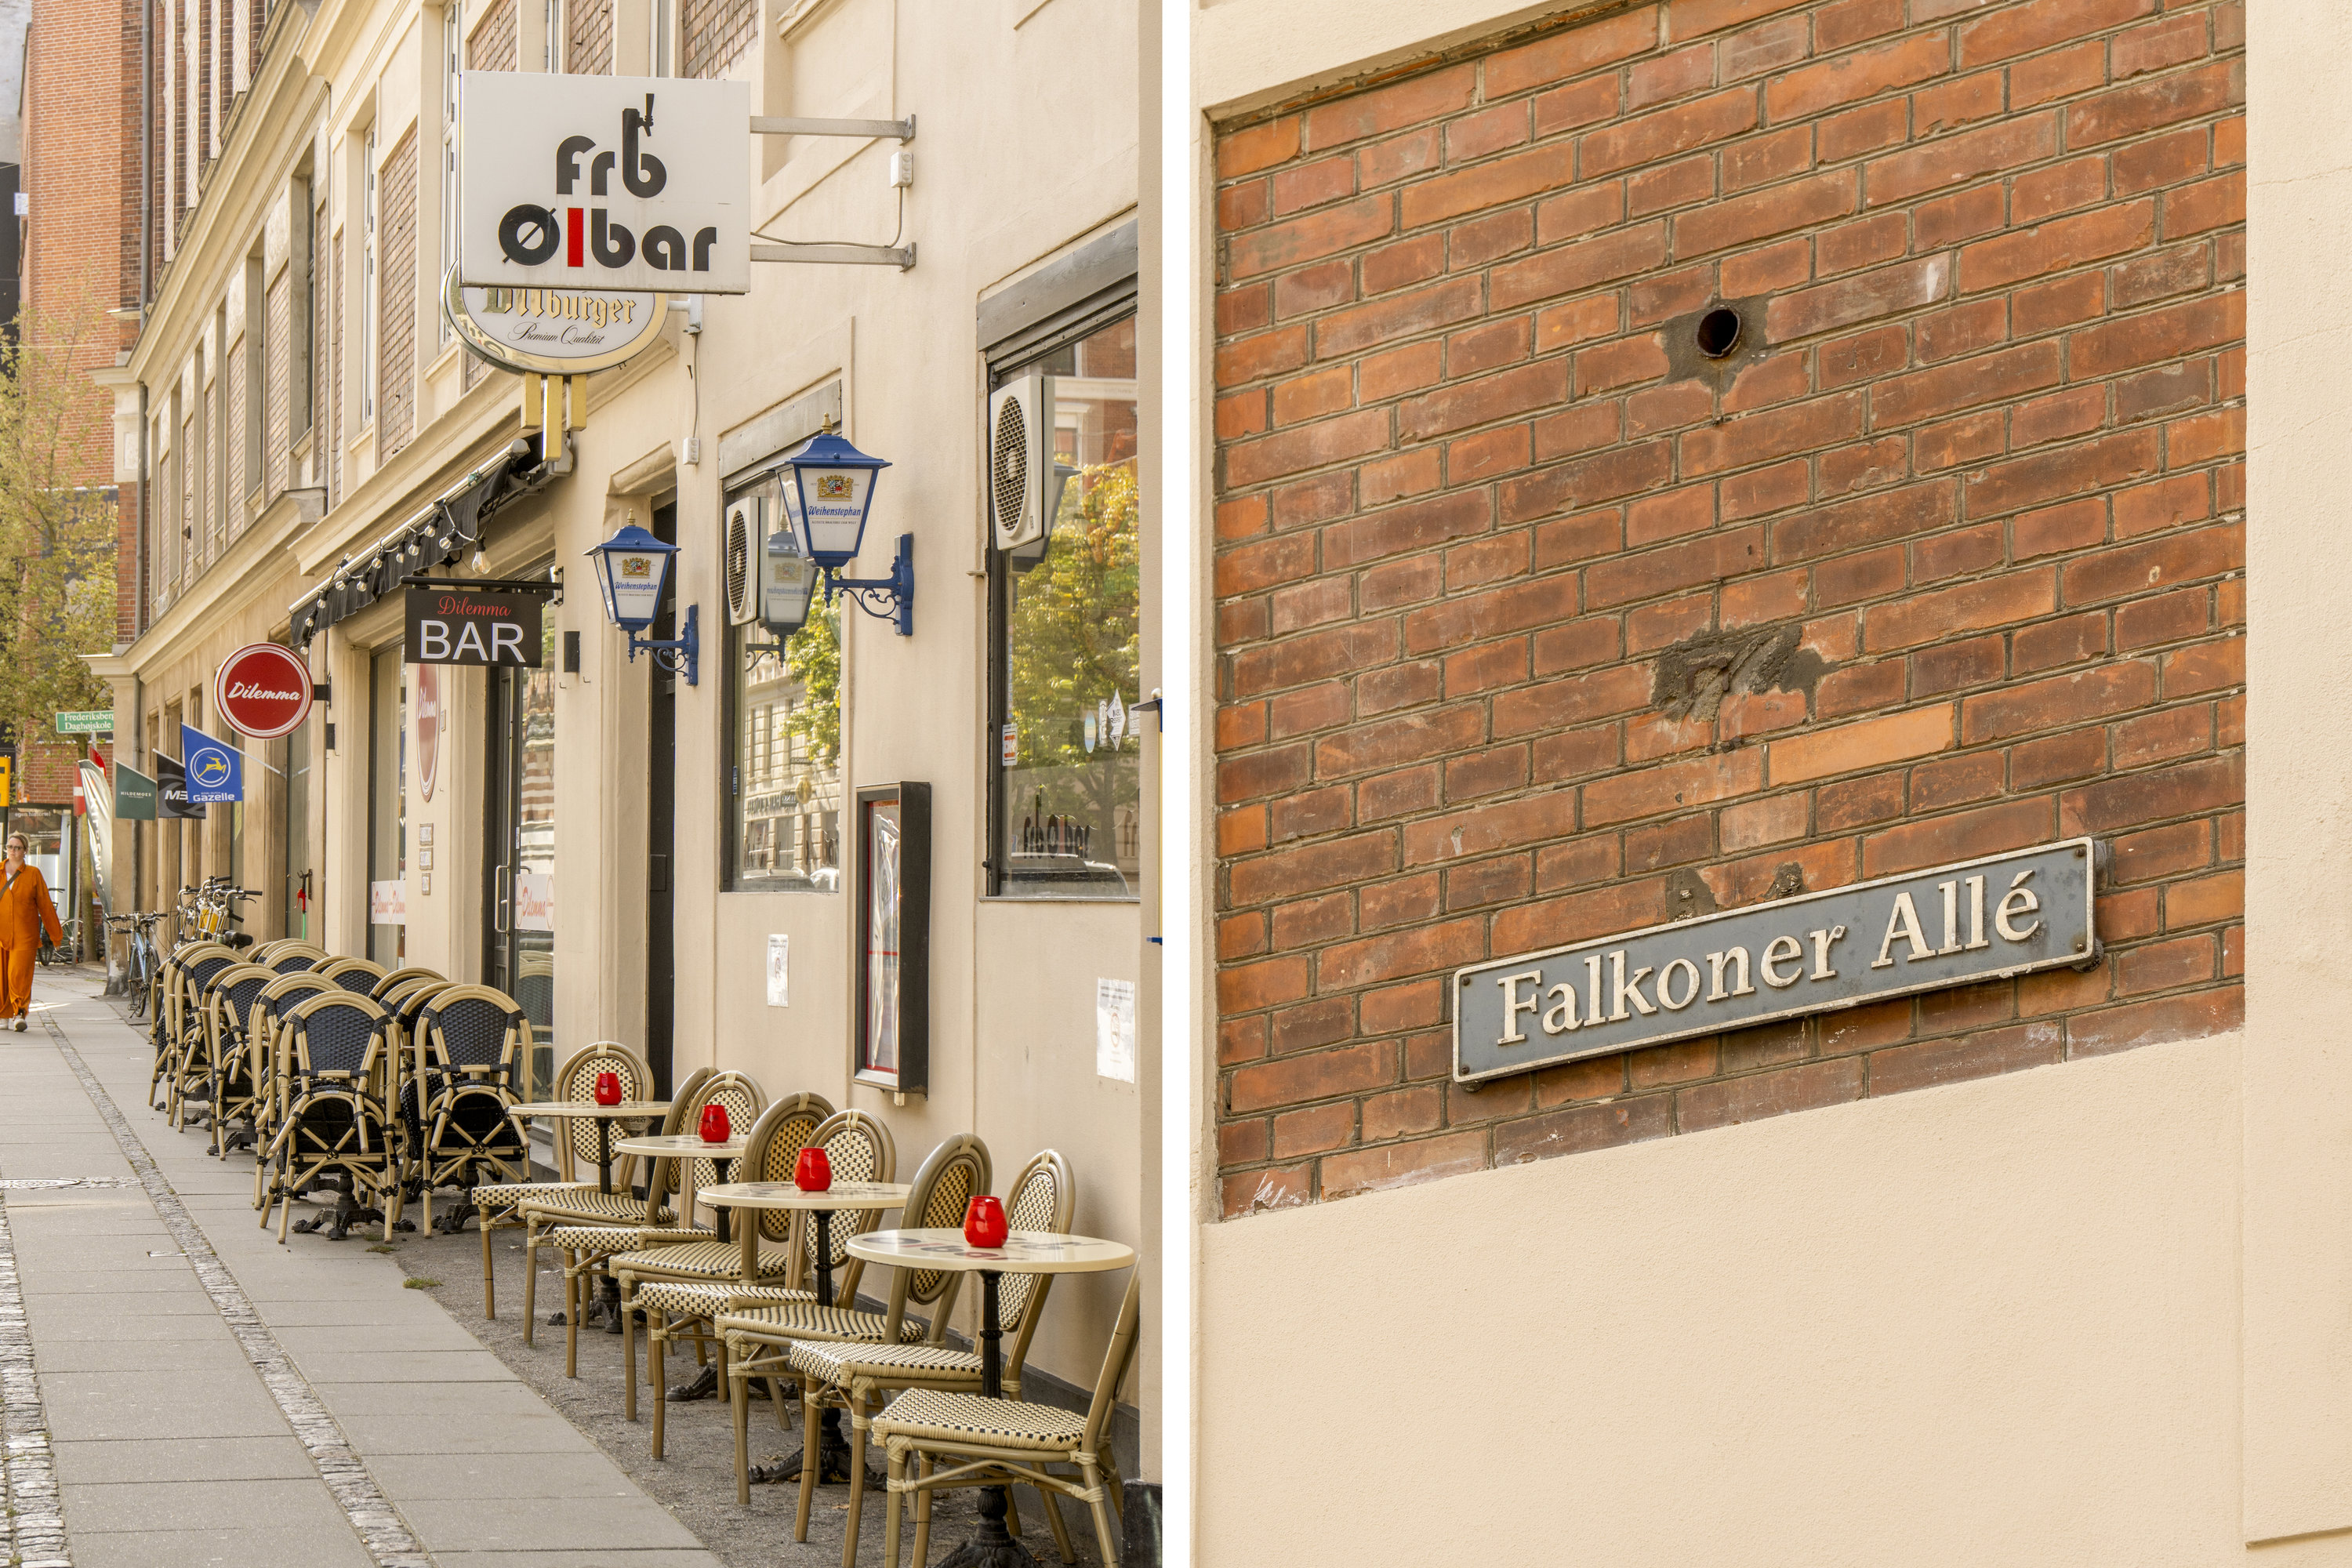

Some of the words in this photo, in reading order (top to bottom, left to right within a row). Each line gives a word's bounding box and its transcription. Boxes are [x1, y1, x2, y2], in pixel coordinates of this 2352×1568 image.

[498, 203, 717, 272] Ølbar
[508, 321, 559, 343] Premium
[560, 324, 605, 345] Qualität
[808, 505, 862, 518] Weihenstephan
[615, 581, 658, 591] Weihenstephan
[437, 595, 512, 616] Dilemma
[420, 619, 526, 662] BAR
[227, 681, 302, 701] Dilemma
[193, 792, 235, 801] Gazelle
[1496, 924, 1846, 1046] Falkoner
[1870, 869, 2041, 970] Allé
